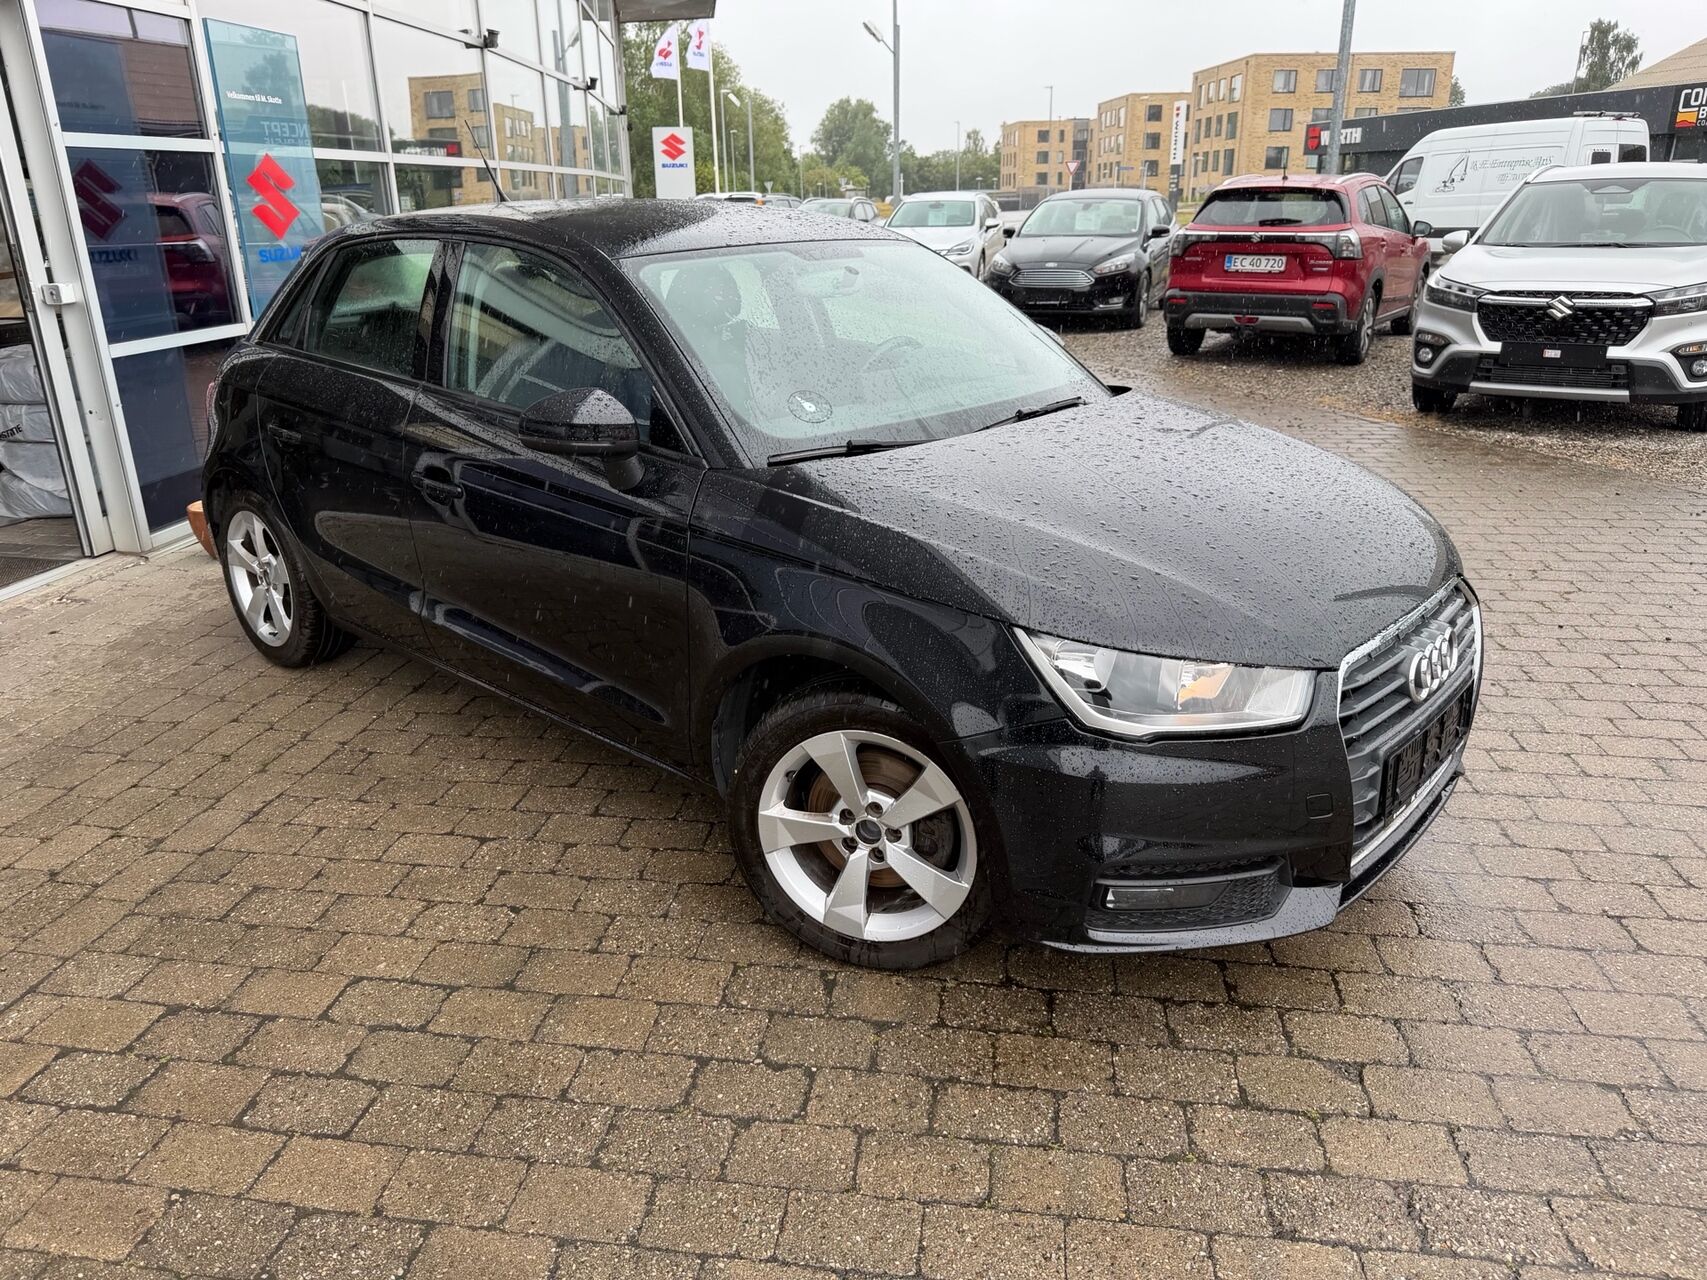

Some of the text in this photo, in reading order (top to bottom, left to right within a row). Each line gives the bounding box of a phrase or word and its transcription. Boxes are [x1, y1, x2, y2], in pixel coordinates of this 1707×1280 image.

[226, 90, 255, 101] Velkommen
[1320, 127, 1362, 146] WRTH
[1233, 257, 1284, 268] EC 40 720
